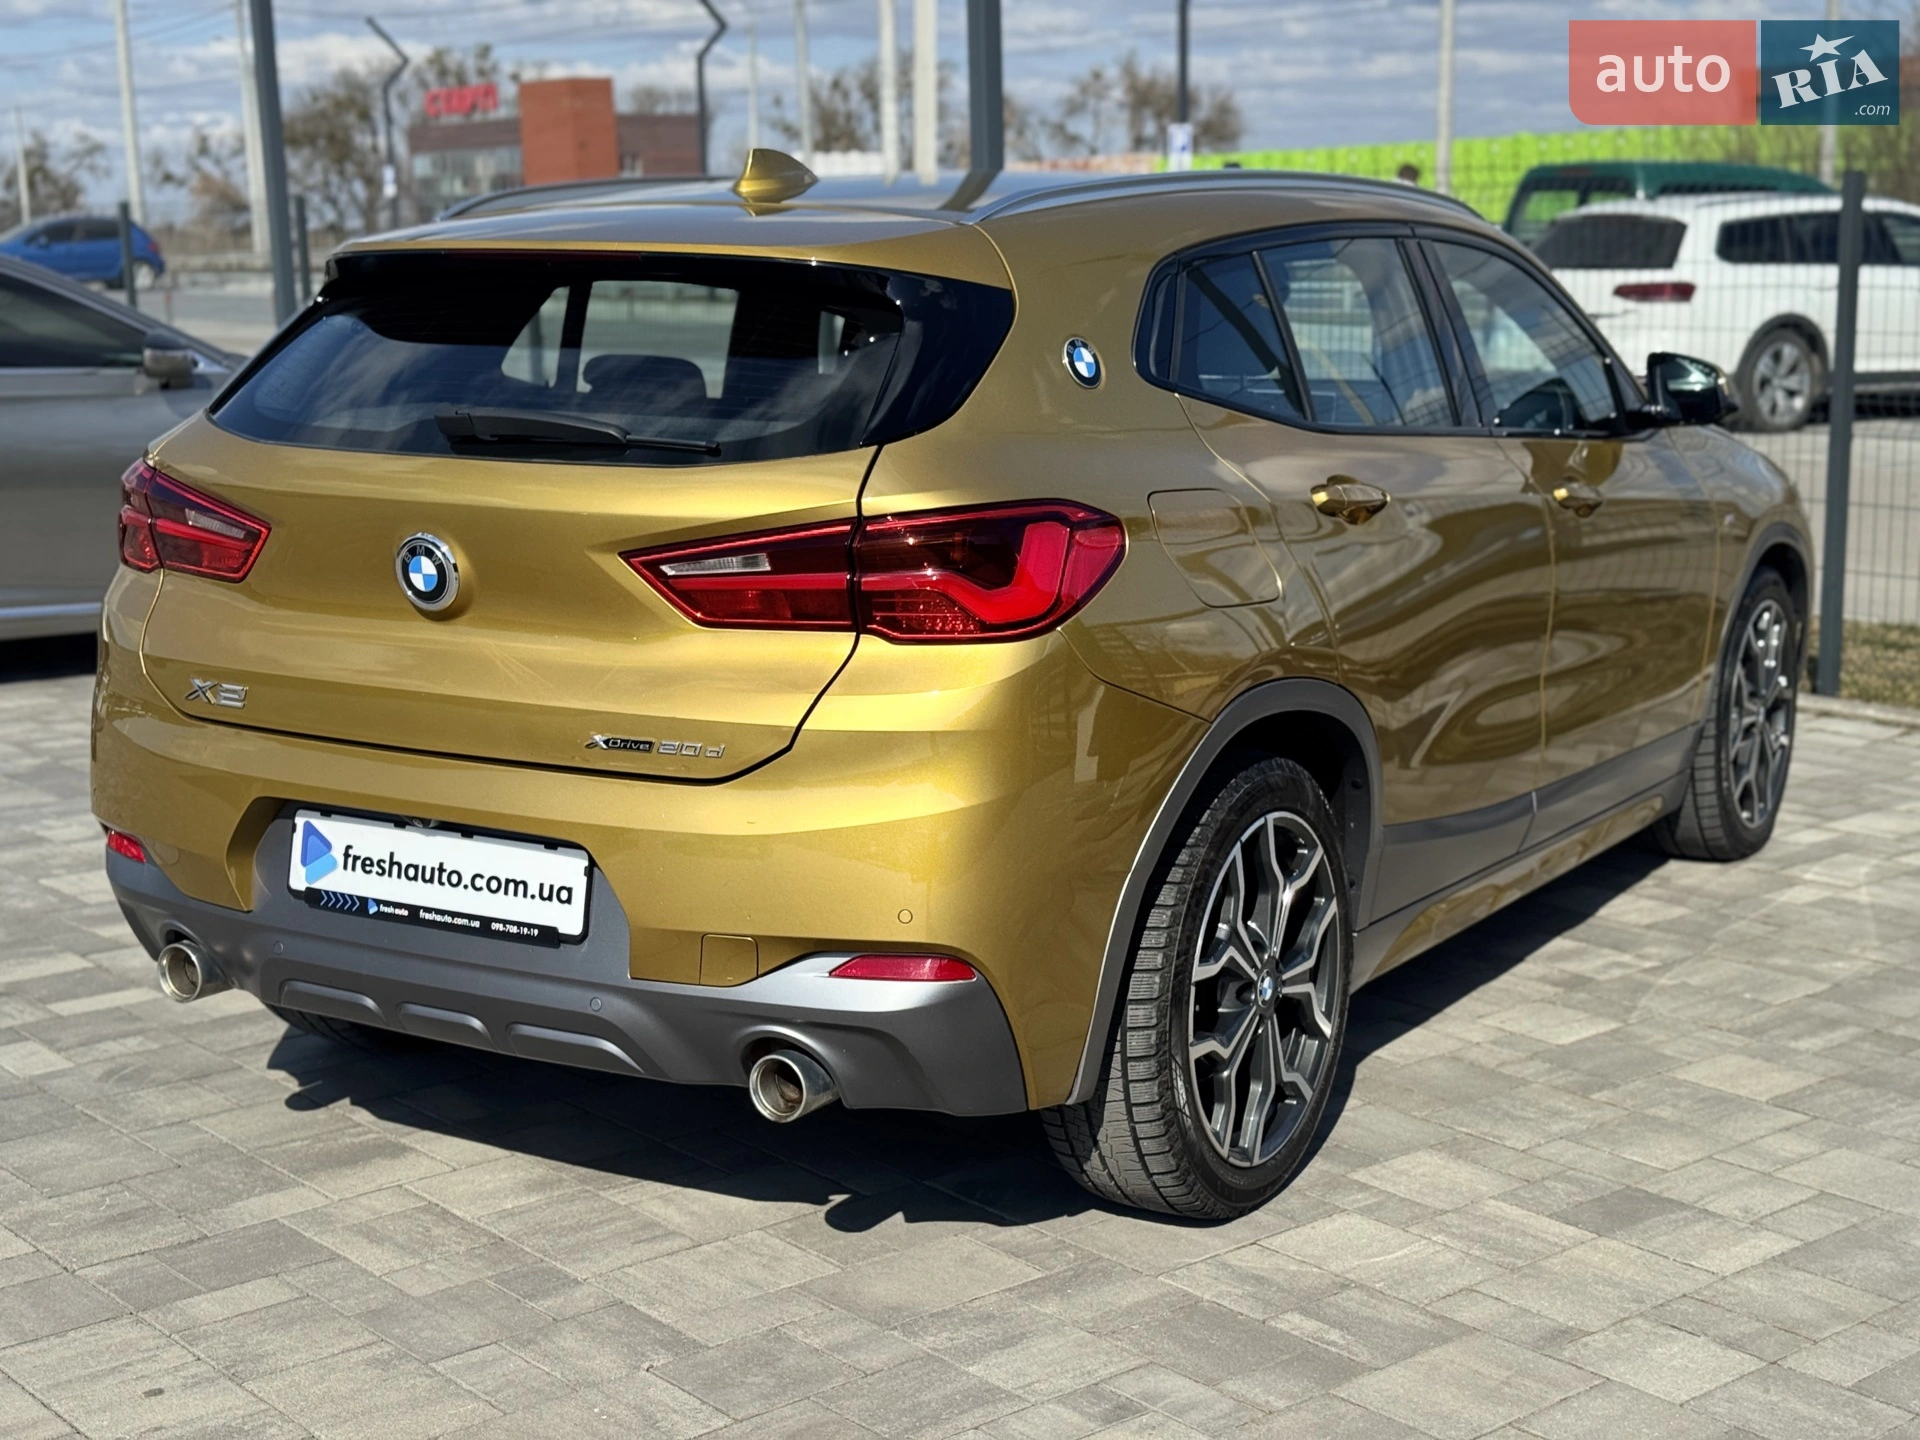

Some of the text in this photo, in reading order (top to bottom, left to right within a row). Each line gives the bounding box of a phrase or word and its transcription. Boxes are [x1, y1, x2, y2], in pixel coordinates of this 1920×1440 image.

[403, 545, 442, 566] BMW
[342, 844, 574, 905] freshauto.com.ua
[419, 909, 480, 928] freshauto.com.ua
